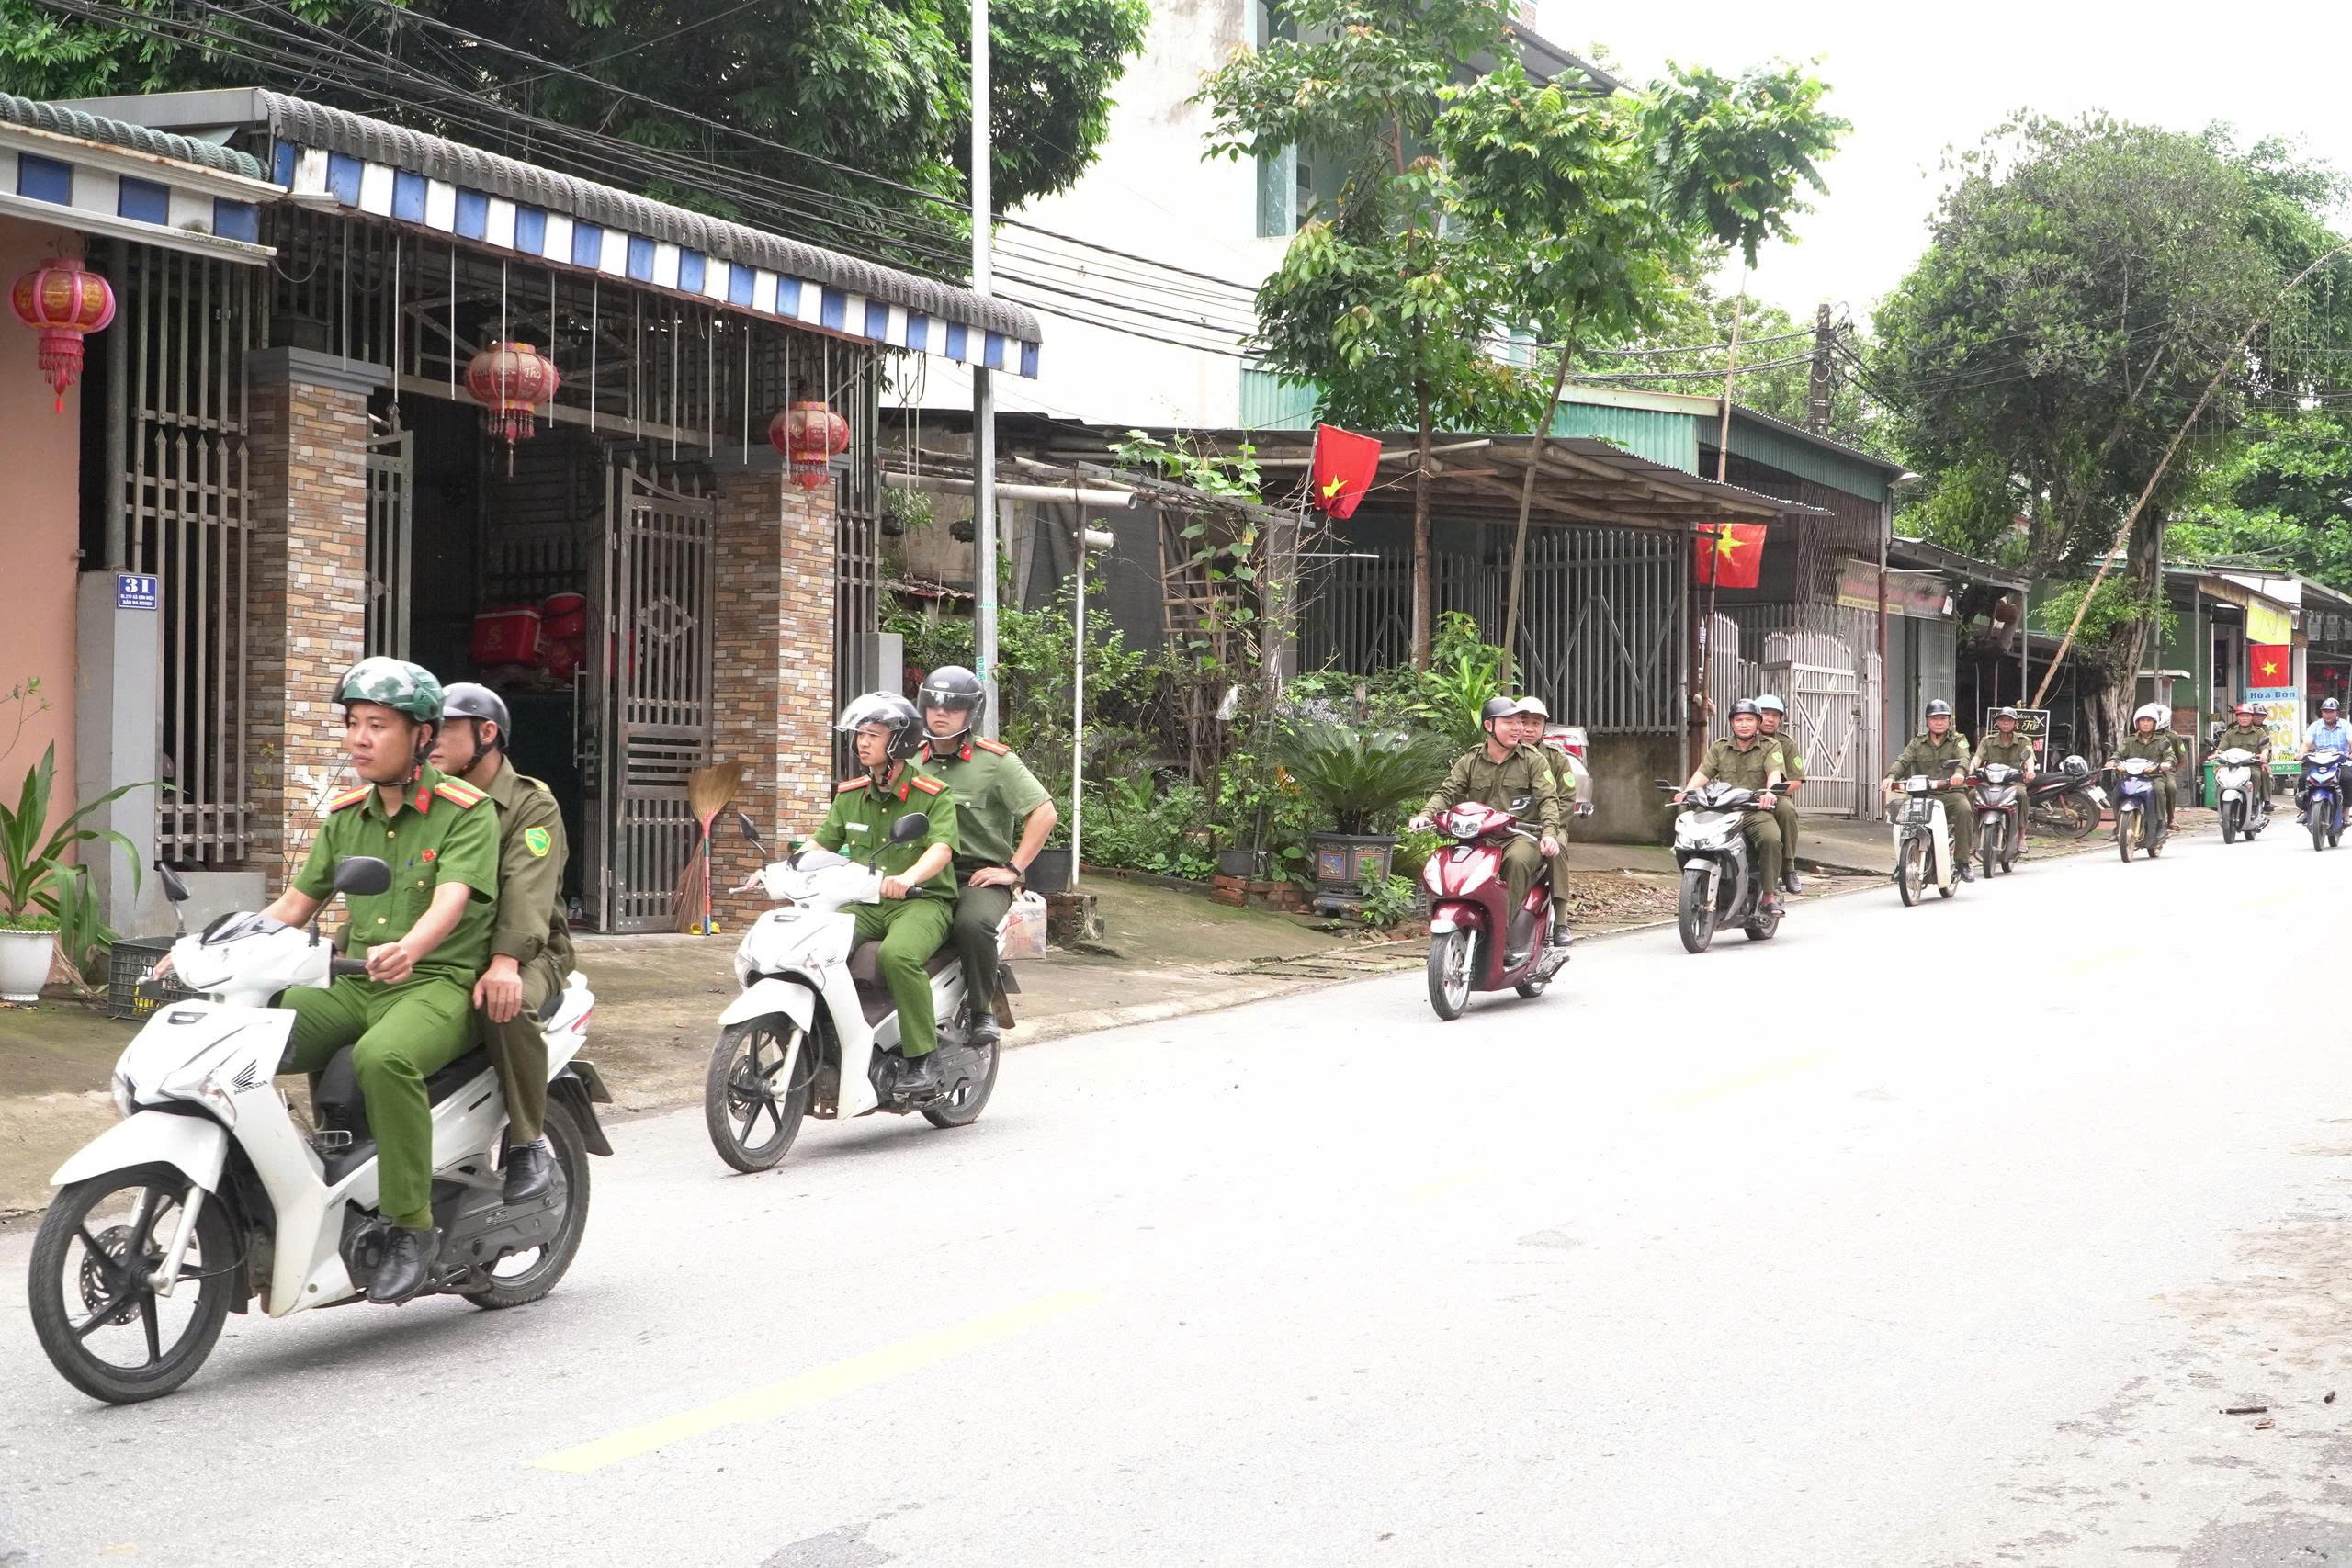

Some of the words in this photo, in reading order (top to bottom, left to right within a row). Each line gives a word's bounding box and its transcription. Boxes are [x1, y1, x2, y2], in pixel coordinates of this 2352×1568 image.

[125, 578, 150, 593] 31
[2266, 703, 2294, 721] ƠM
[824, 959, 844, 968] HONDA
[233, 1080, 268, 1095] HONDA
